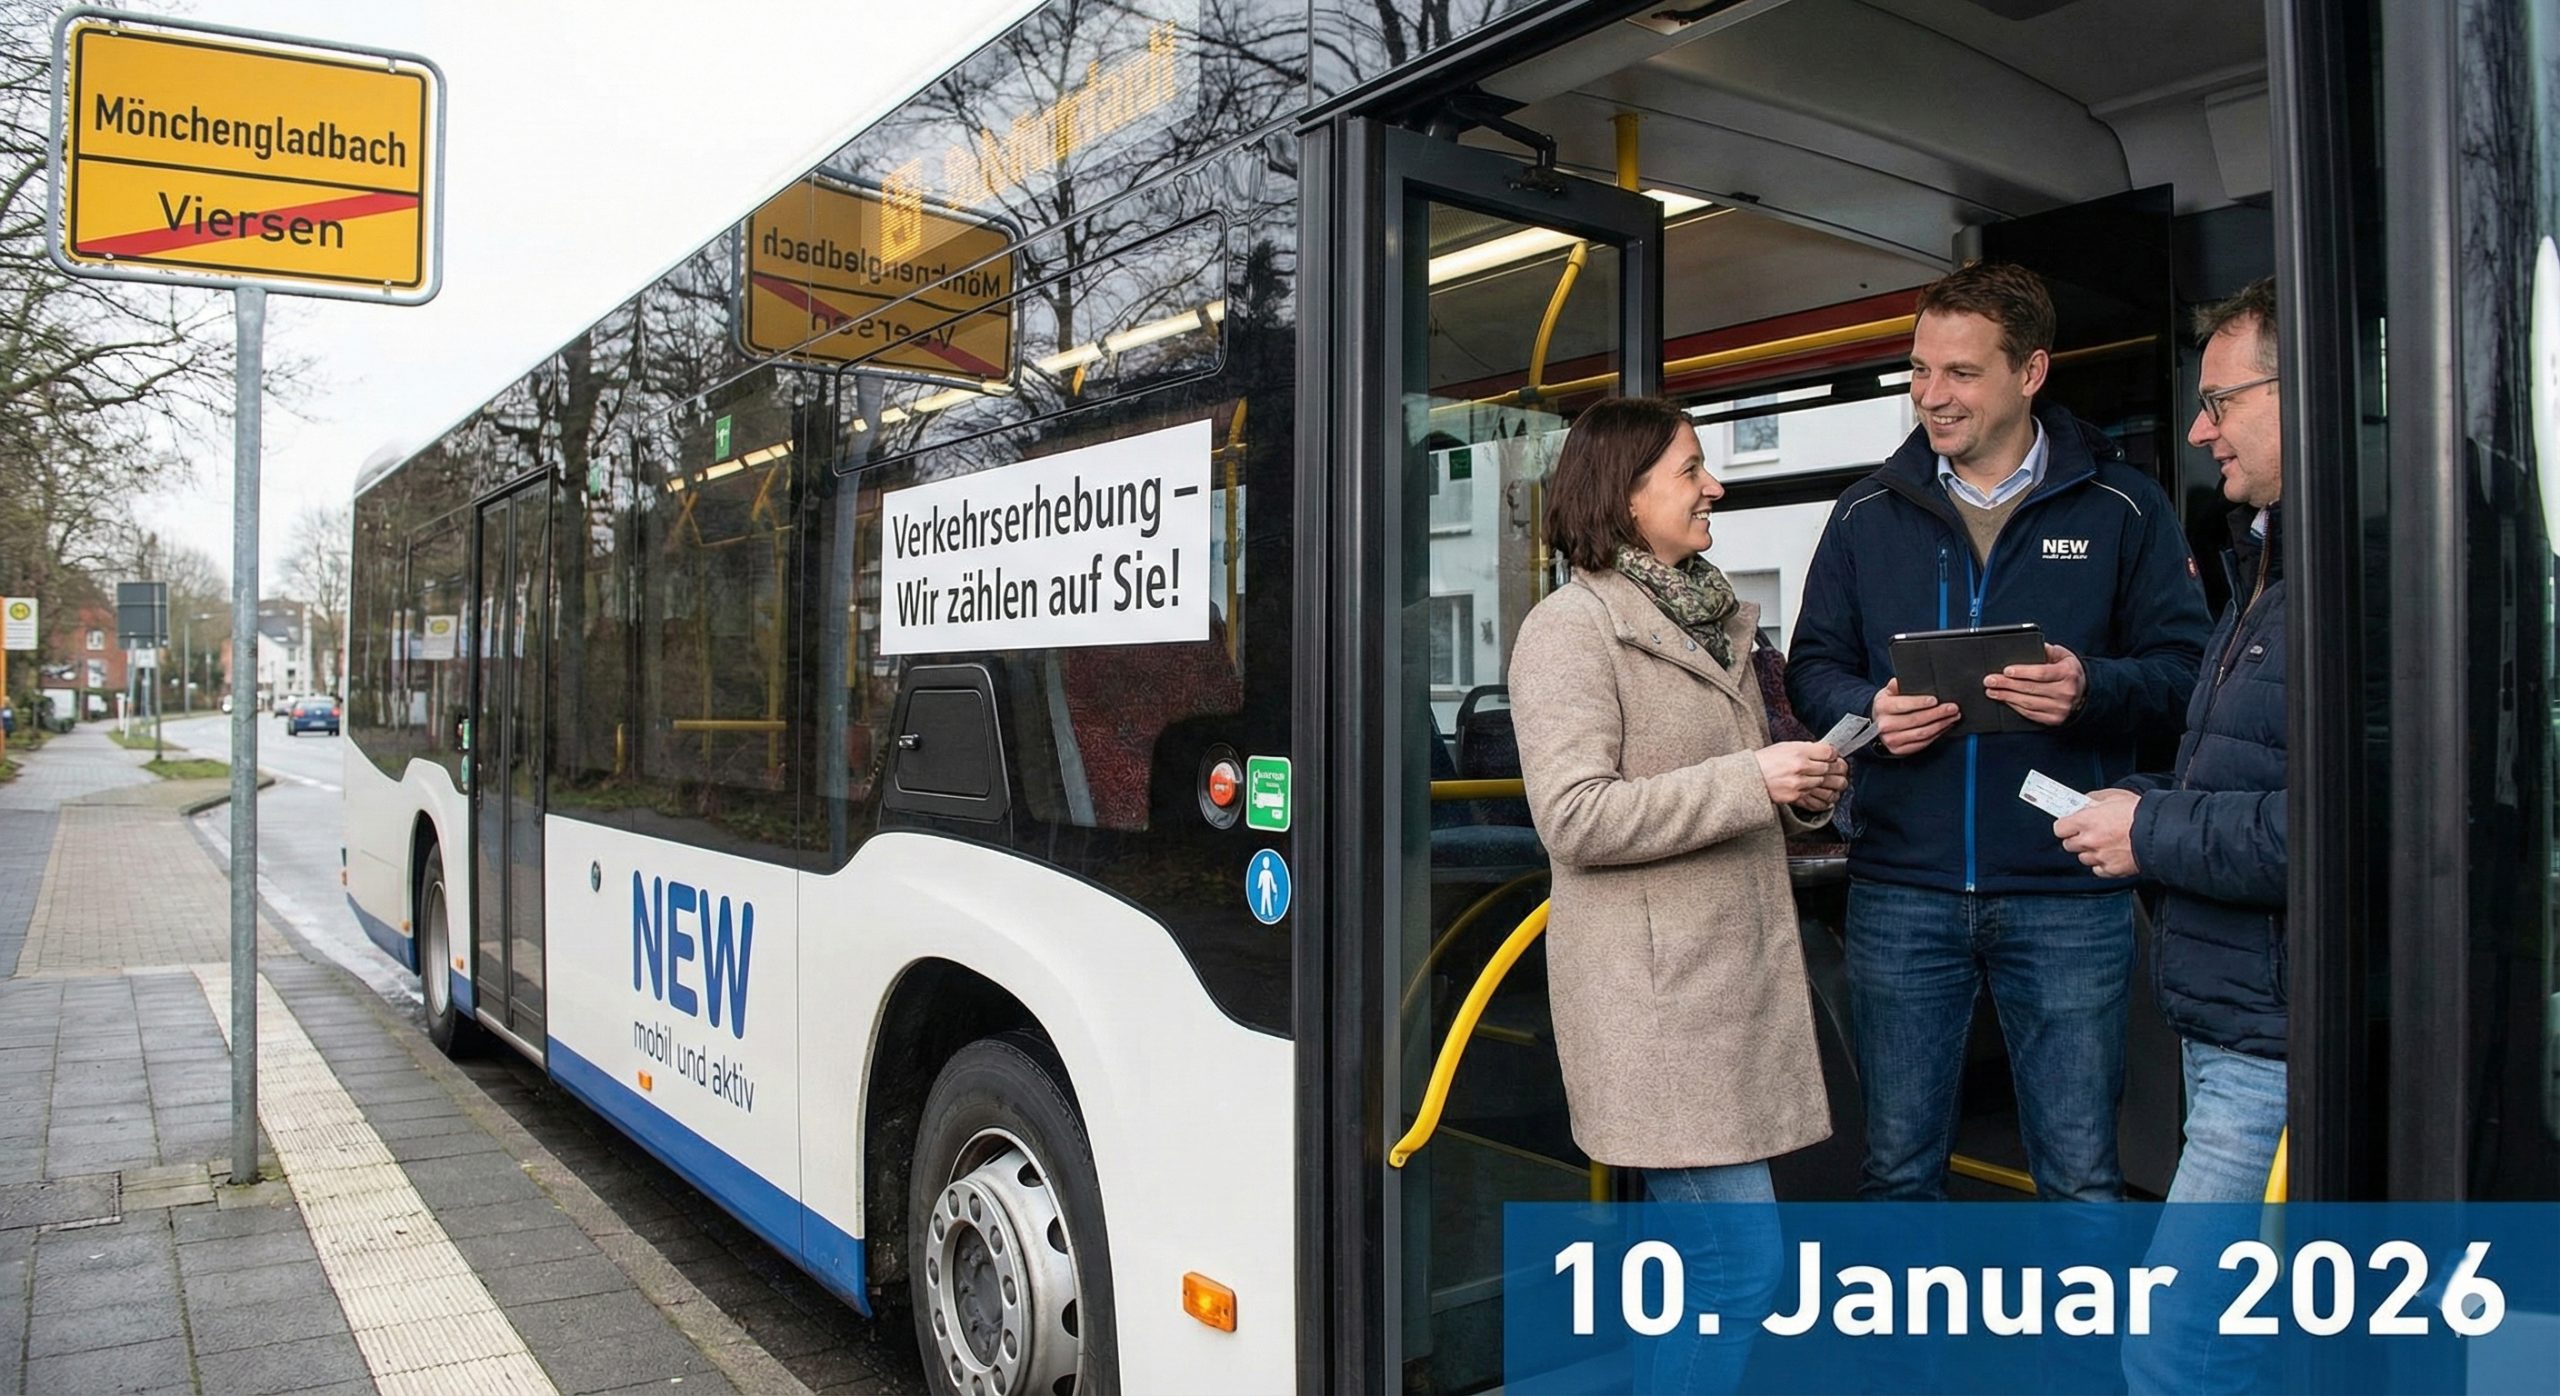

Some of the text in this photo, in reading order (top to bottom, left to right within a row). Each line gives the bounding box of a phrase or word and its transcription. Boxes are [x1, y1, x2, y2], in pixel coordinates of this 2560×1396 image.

[95, 93, 406, 168] Mönchengladbach
[158, 192, 344, 248] Viersen
[893, 475, 1162, 559] Verkehrserhebung
[2042, 538, 2089, 554] NEW
[897, 548, 1180, 627] Wir zählen auf Sie!
[633, 869, 755, 1040] NEW
[634, 1021, 755, 1114] mobil und aktiv
